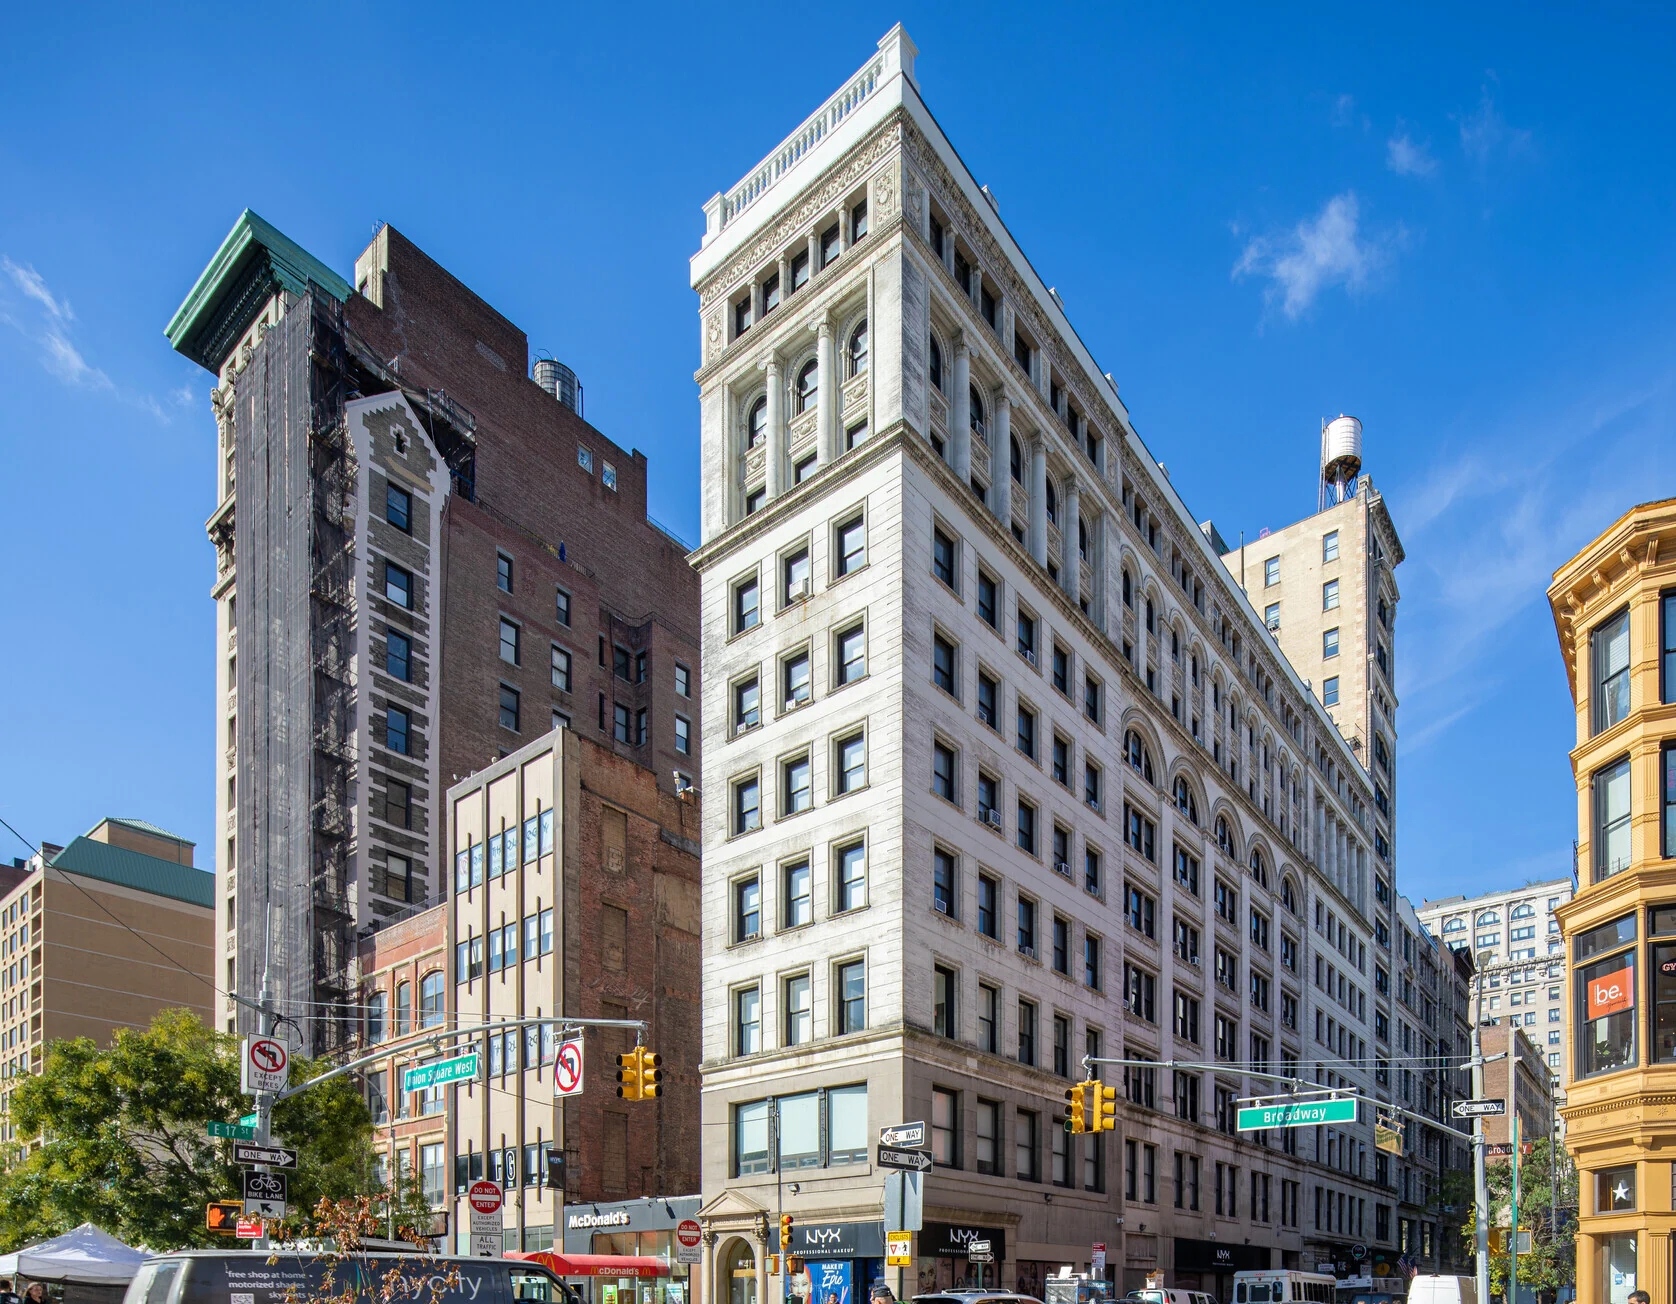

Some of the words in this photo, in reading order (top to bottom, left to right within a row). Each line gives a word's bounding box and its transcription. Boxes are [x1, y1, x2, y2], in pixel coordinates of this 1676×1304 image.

[254, 1071, 283, 1082] EXCEPT
[407, 1072, 426, 1087] Union
[427, 1066, 453, 1082] Square
[454, 1059, 473, 1076] West
[257, 1081, 279, 1089] BIKES
[1458, 1105, 1475, 1113] ONE
[1263, 1108, 1327, 1123] Broadway
[214, 1124, 220, 1135] E
[225, 1126, 237, 1136] 17
[885, 1132, 899, 1142] ONE
[905, 1129, 920, 1140] WAY
[243, 1150, 262, 1160] ONE
[269, 1153, 288, 1162] WAY
[882, 1151, 899, 1163] ONE
[907, 1155, 926, 1166] WAY
[568, 1211, 629, 1229] McDonald's
[806, 1227, 841, 1244] NYX
[950, 1228, 979, 1243] NYX
[1217, 1250, 1230, 1259] NYX
[248, 1271, 270, 1279] shop
[822, 1270, 843, 1290] Epic
[228, 1281, 274, 1289] motorized
